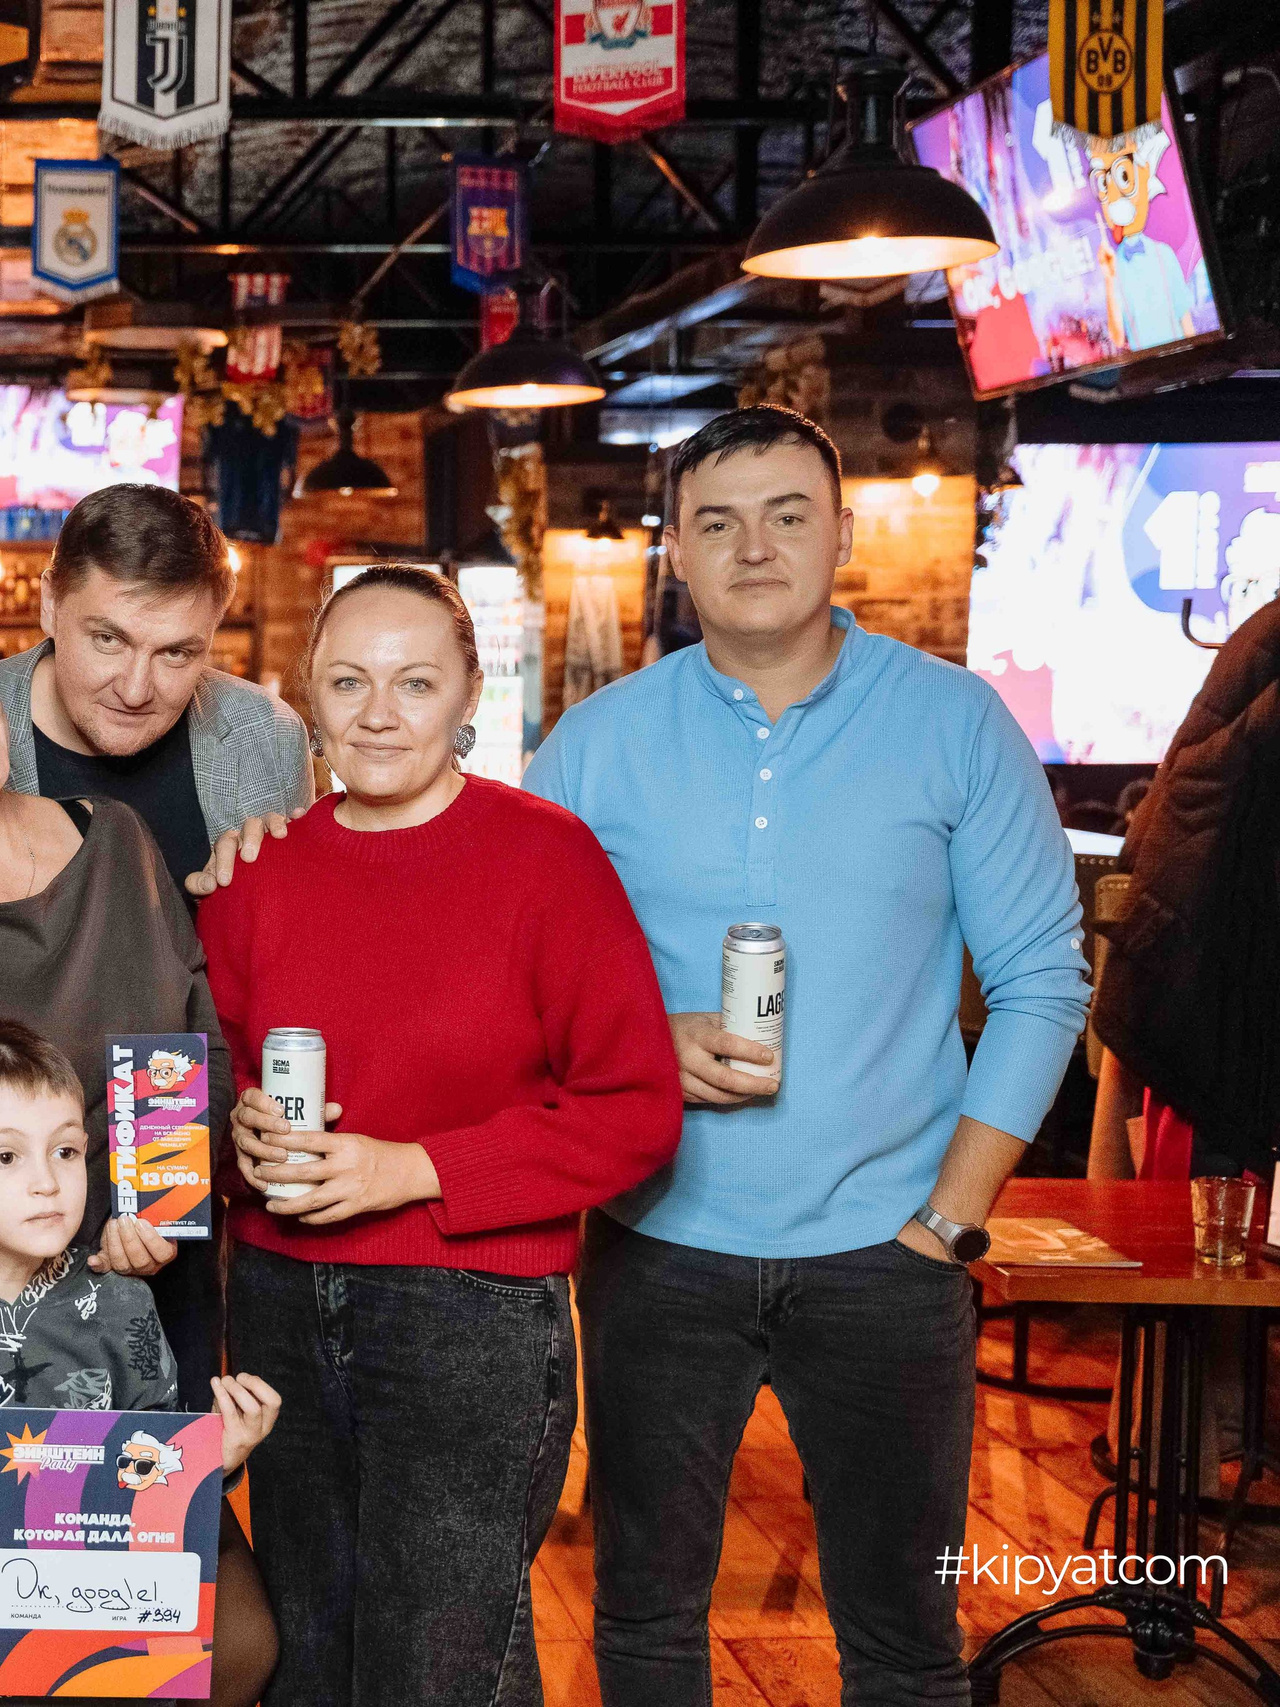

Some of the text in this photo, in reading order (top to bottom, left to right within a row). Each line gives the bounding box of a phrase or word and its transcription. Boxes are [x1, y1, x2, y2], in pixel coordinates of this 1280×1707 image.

[272, 1058, 290, 1067] SIGMA
[268, 1095, 305, 1120] GER
[141, 1172, 160, 1186] 13
[162, 1171, 200, 1186] 000
[40, 1456, 77, 1473] Party
[55, 1512, 136, 1527] КОМАНДА,
[13, 1529, 176, 1544] КОТОРАЯ ДАЛА ОГНЯ
[137, 1608, 181, 1624] #394
